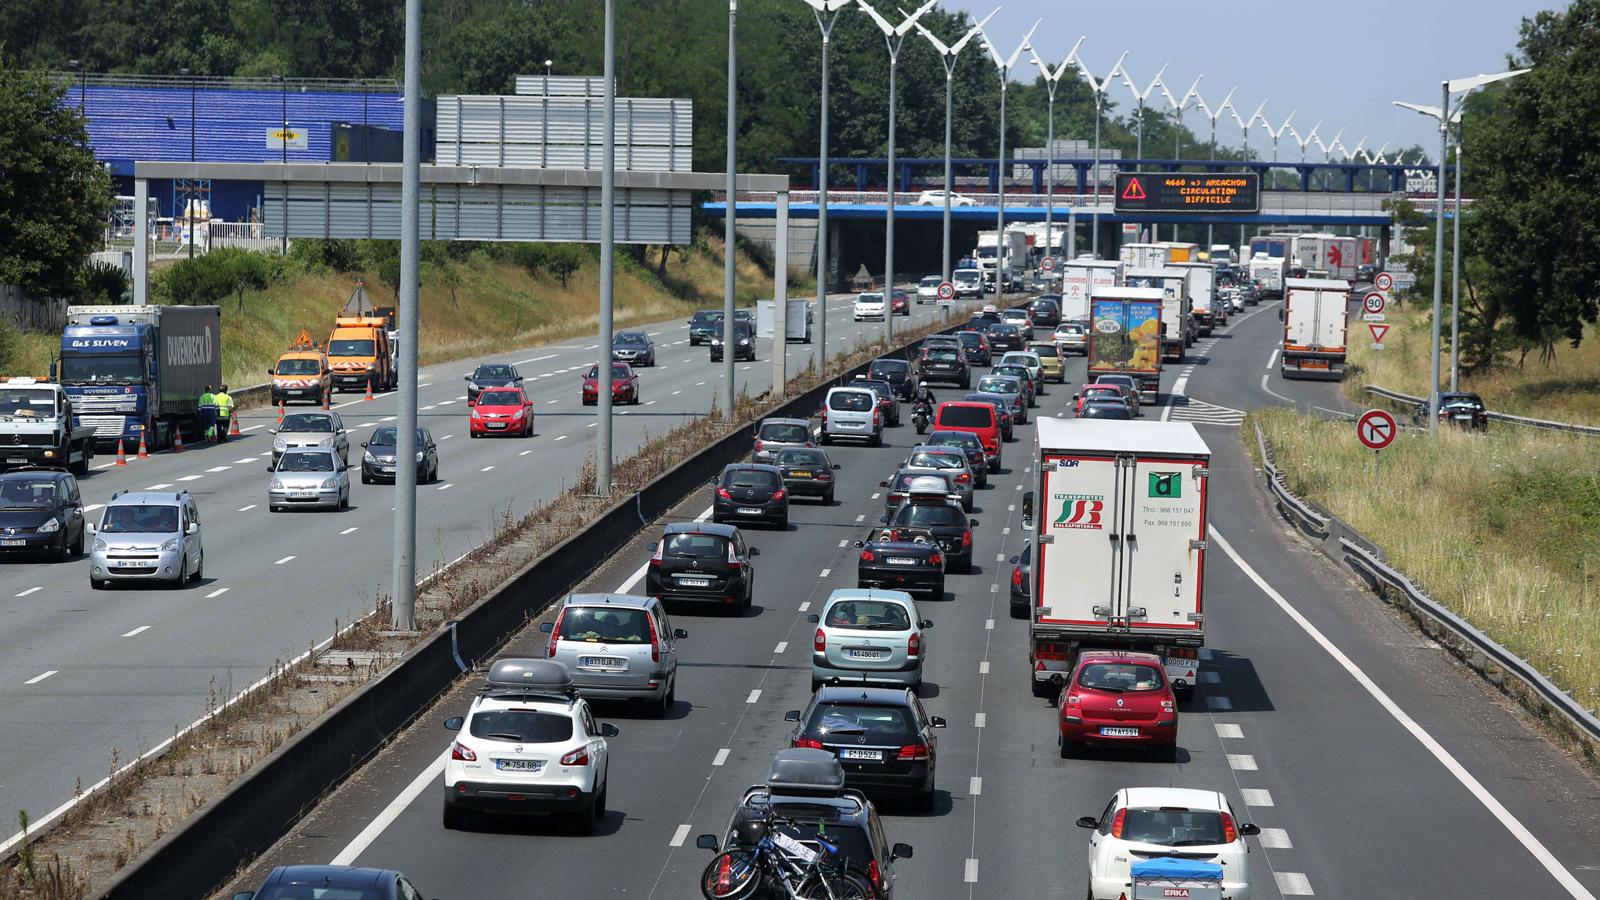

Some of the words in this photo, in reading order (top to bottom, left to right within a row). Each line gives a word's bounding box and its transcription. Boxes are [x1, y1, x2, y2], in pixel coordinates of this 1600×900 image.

[1180, 187, 1237, 195] CIRCULATION
[1185, 196, 1231, 204] DIFFICILE
[1378, 278, 1389, 286] 80
[941, 287, 951, 295] 90
[1368, 299, 1381, 308] 90
[92, 340, 128, 348] SLIVEN
[167, 335, 206, 366] DUVENBECK
[1165, 889, 1189, 897] ERKA
